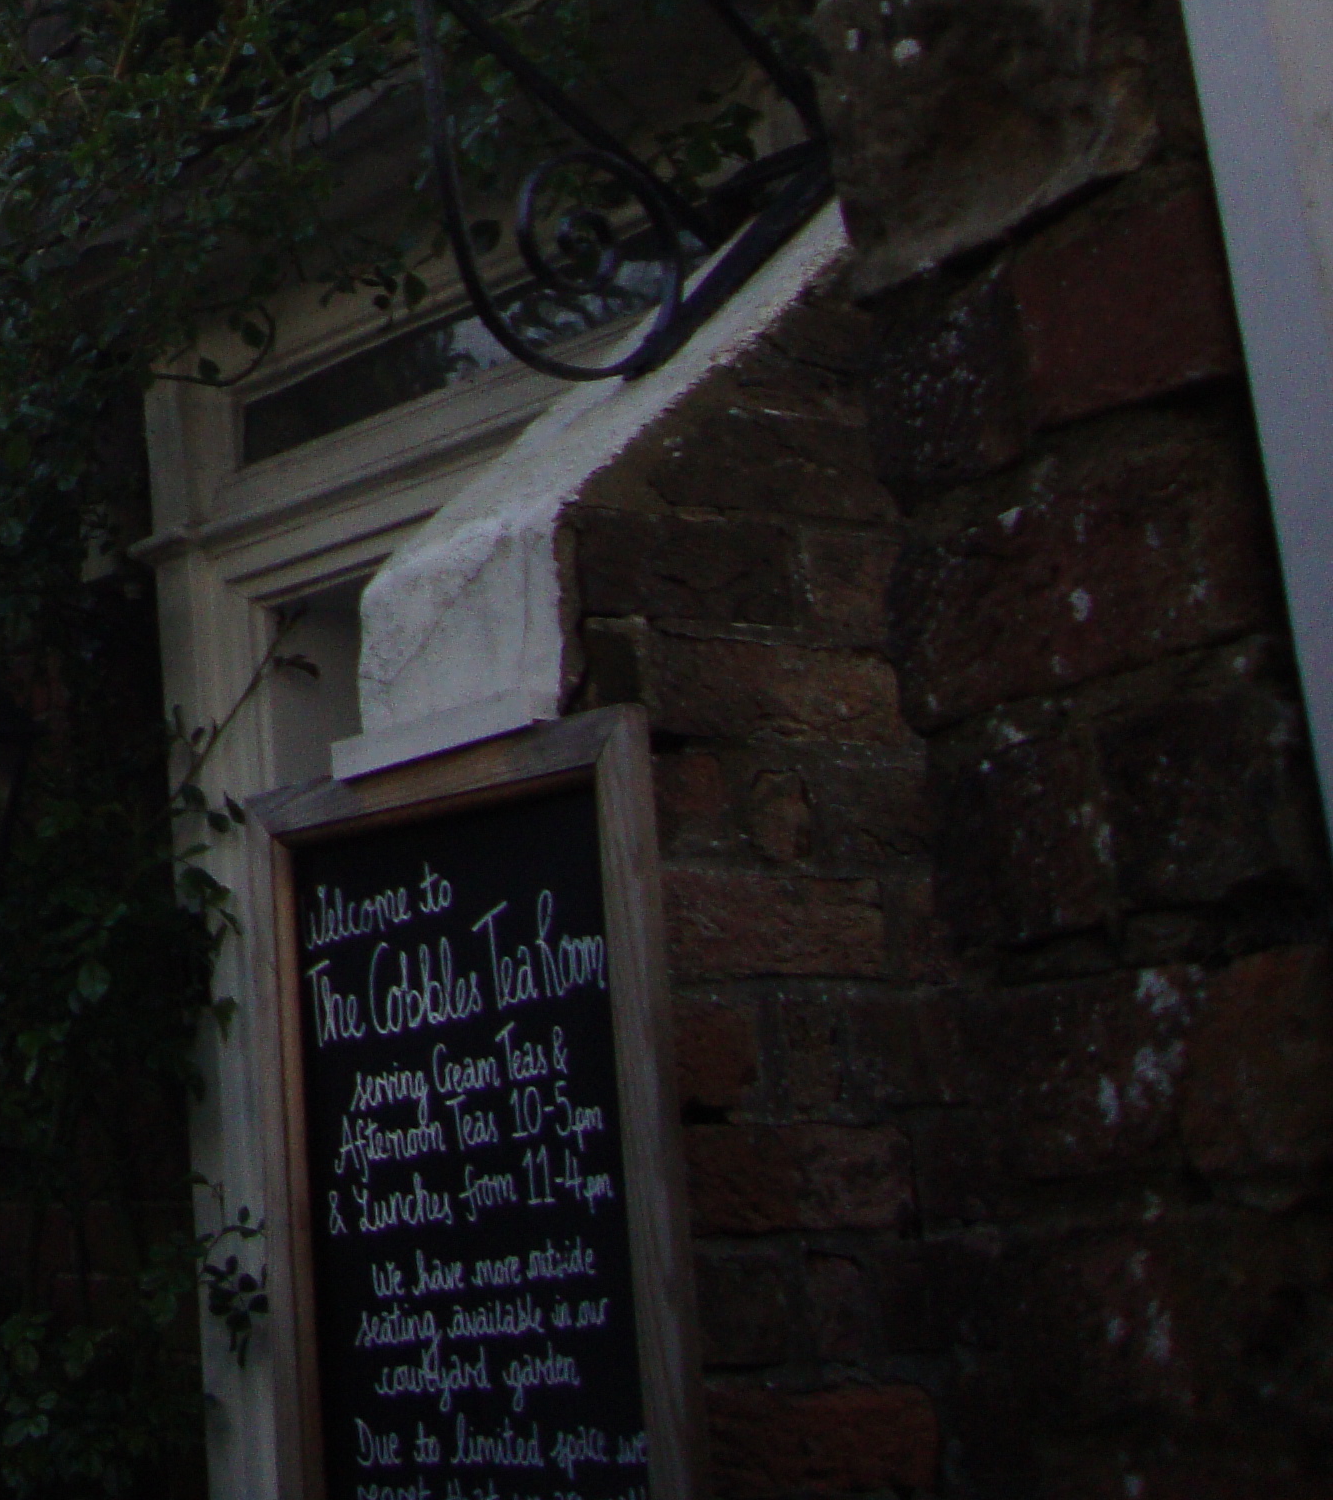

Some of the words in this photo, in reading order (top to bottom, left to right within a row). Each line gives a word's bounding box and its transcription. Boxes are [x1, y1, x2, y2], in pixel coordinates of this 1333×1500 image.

[304, 883, 412, 951] Welcome
[419, 861, 453, 913] to
[304, 959, 367, 1048] The
[368, 936, 483, 1035] Cobbles
[471, 900, 539, 1010] Tea
[535, 889, 607, 998] Room
[349, 1062, 429, 1126] serving
[431, 1042, 501, 1093] Cream
[494, 1021, 549, 1081] Teas
[551, 1025, 569, 1075] &
[334, 1114, 446, 1183] Afternoon
[445, 1094, 499, 1150] Teas
[327, 1189, 349, 1235] &
[352, 1171, 454, 1233] Lunches
[458, 1163, 518, 1223] from
[370, 1259, 405, 1298] We
[412, 1248, 465, 1296] have
[471, 1255, 523, 1287] more
[355, 1301, 442, 1364] seating
[446, 1292, 545, 1340] available
[551, 1295, 573, 1328] in
[574, 1296, 610, 1329] our
[374, 1345, 492, 1412] courtyard
[501, 1341, 581, 1412] garden
[353, 1416, 403, 1467] Due
[413, 1421, 441, 1463] to
[450, 1412, 545, 1467] limited
[550, 1425, 610, 1480] space
